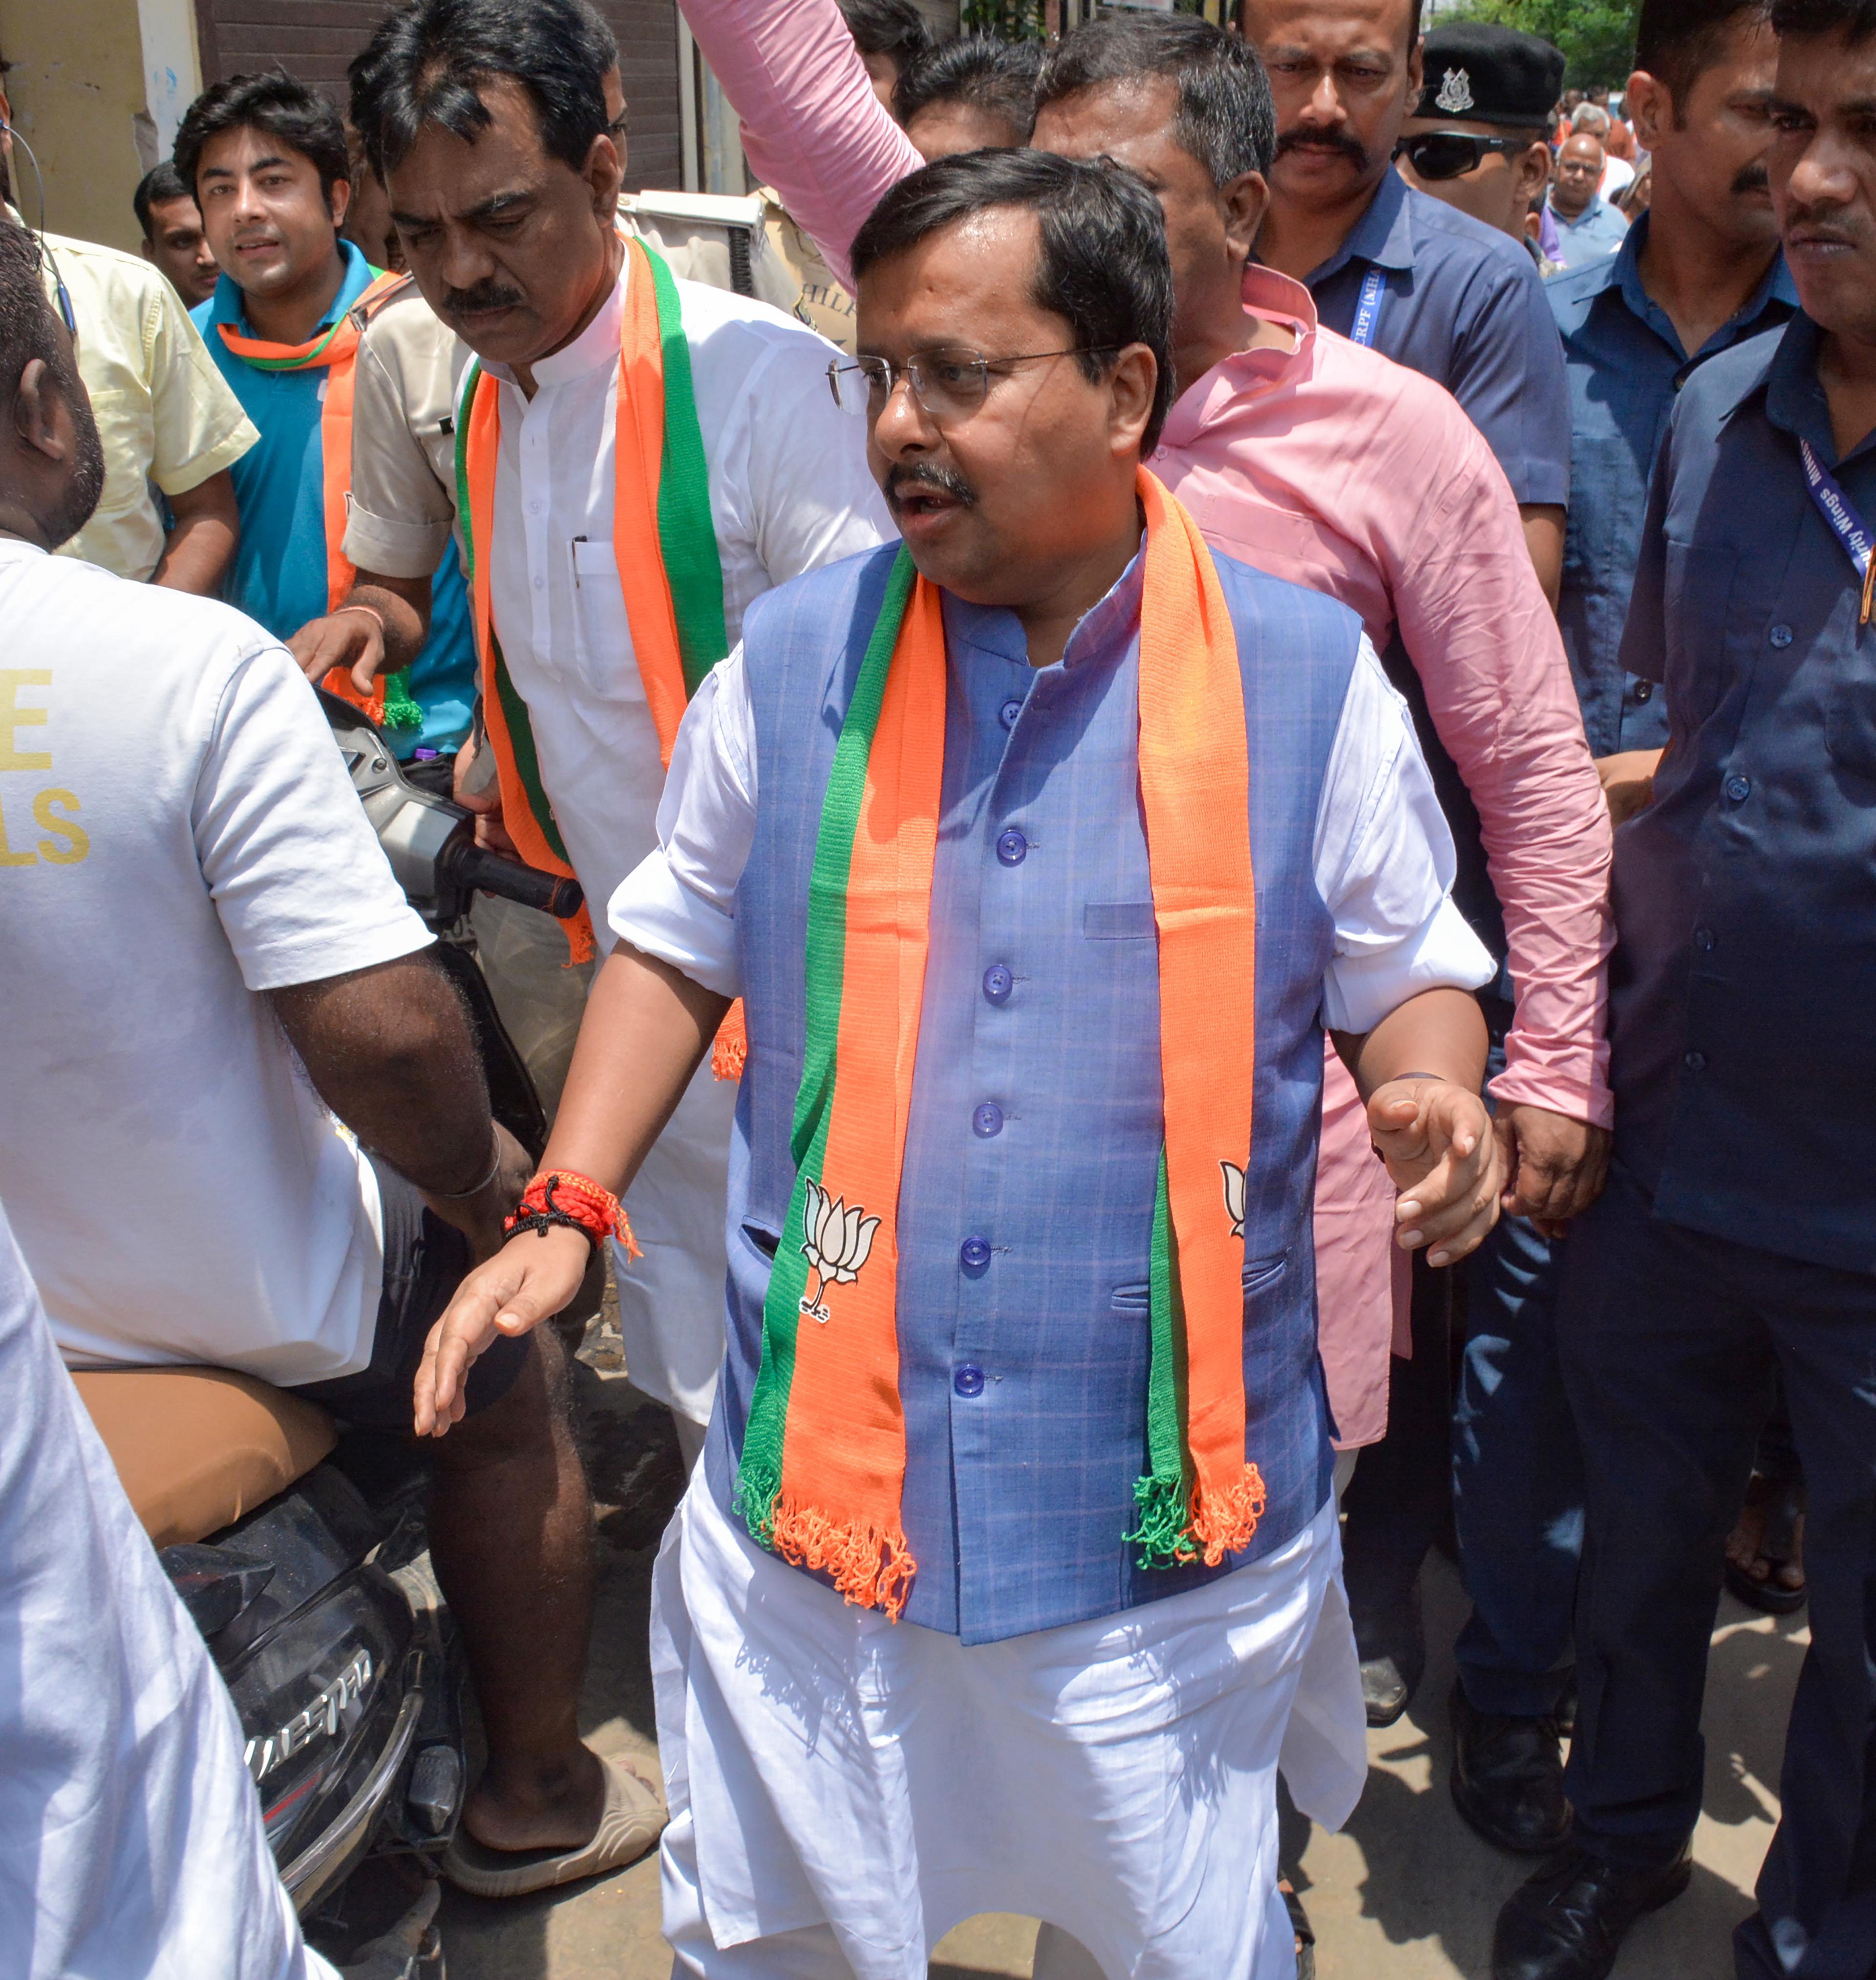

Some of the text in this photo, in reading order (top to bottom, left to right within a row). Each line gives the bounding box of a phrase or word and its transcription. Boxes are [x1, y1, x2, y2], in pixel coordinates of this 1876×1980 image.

[1354, 308, 1371, 345] CRPF
[1820, 488, 1853, 535] Wings
[1848, 530, 1871, 568] urity
